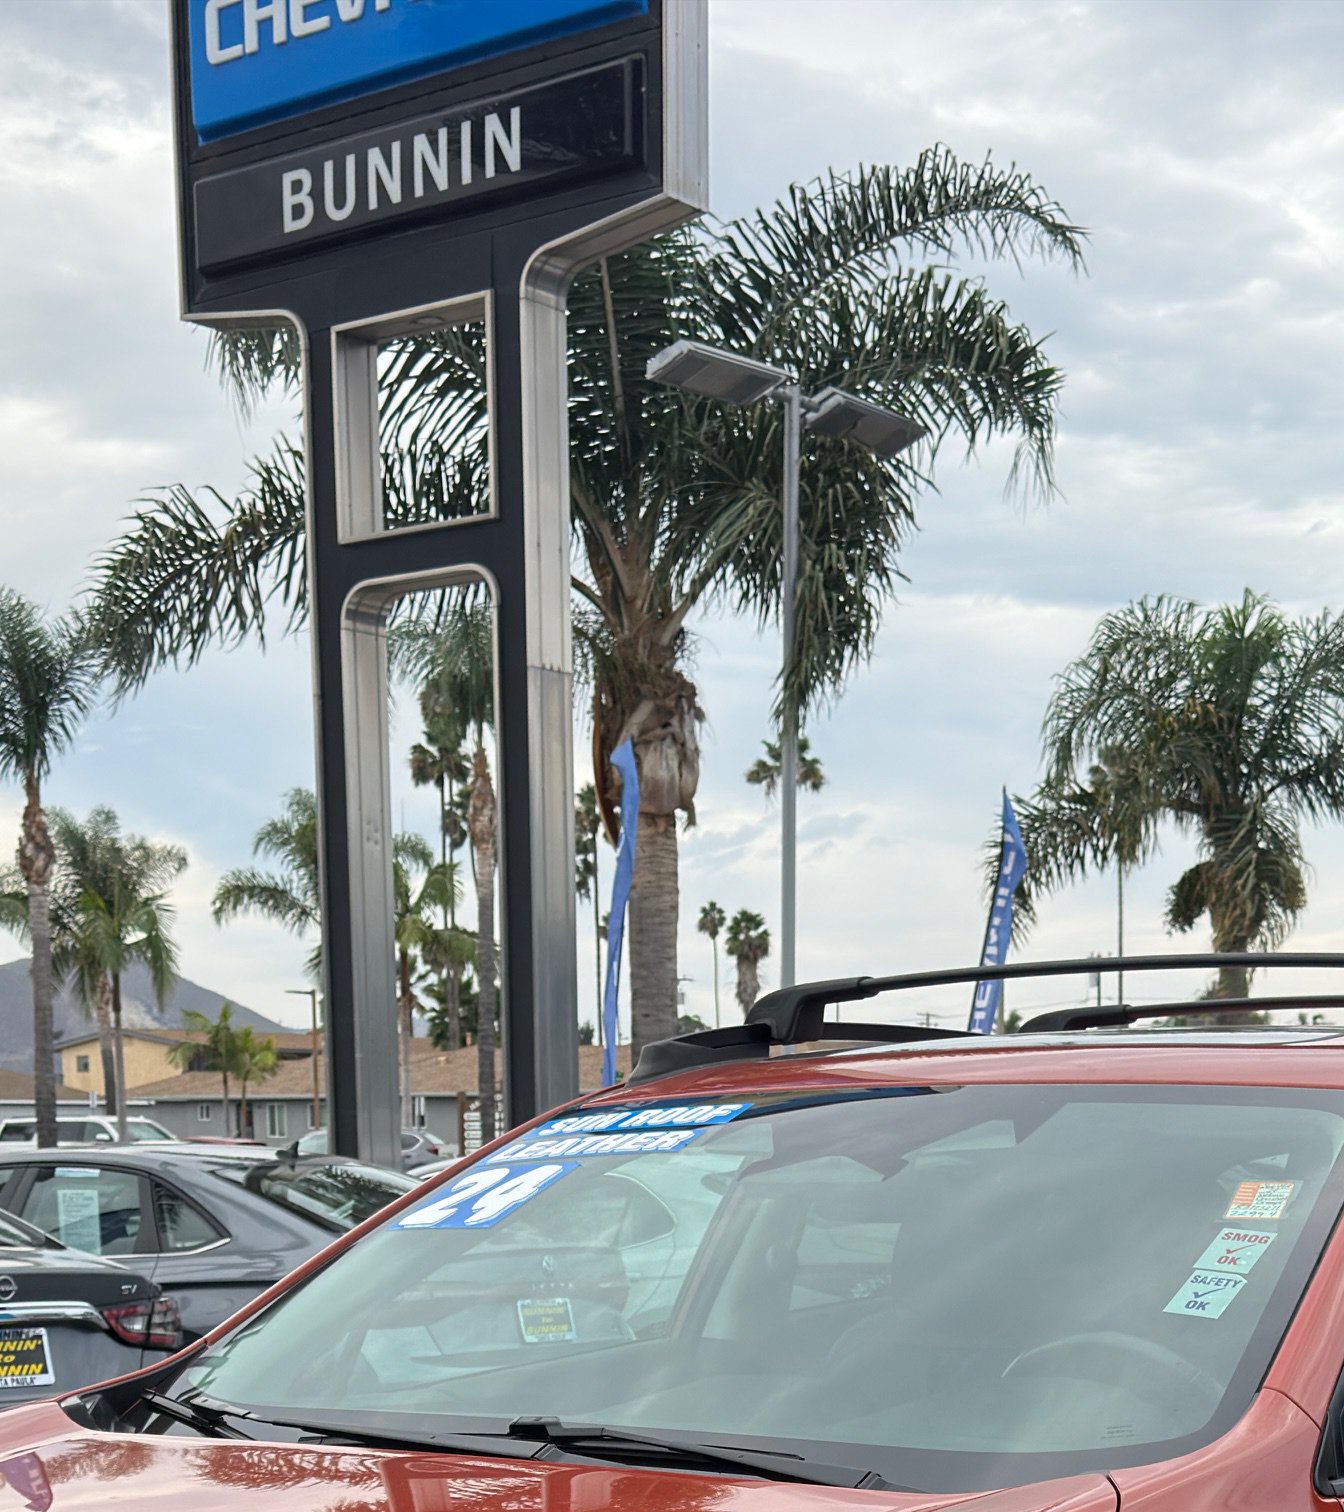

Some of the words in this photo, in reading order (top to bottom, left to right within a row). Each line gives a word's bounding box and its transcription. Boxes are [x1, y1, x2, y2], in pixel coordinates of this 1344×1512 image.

[282, 106, 522, 233] BUNNIN
[538, 1113, 619, 1137] SUN
[626, 1103, 742, 1127] ROOF
[487, 1130, 697, 1163] LEATHER
[398, 1164, 564, 1228] 24
[1221, 1232, 1270, 1244] SMOG
[1216, 1256, 1240, 1265] OK
[1191, 1275, 1244, 1288] SAFETY
[1185, 1300, 1210, 1311] OK
